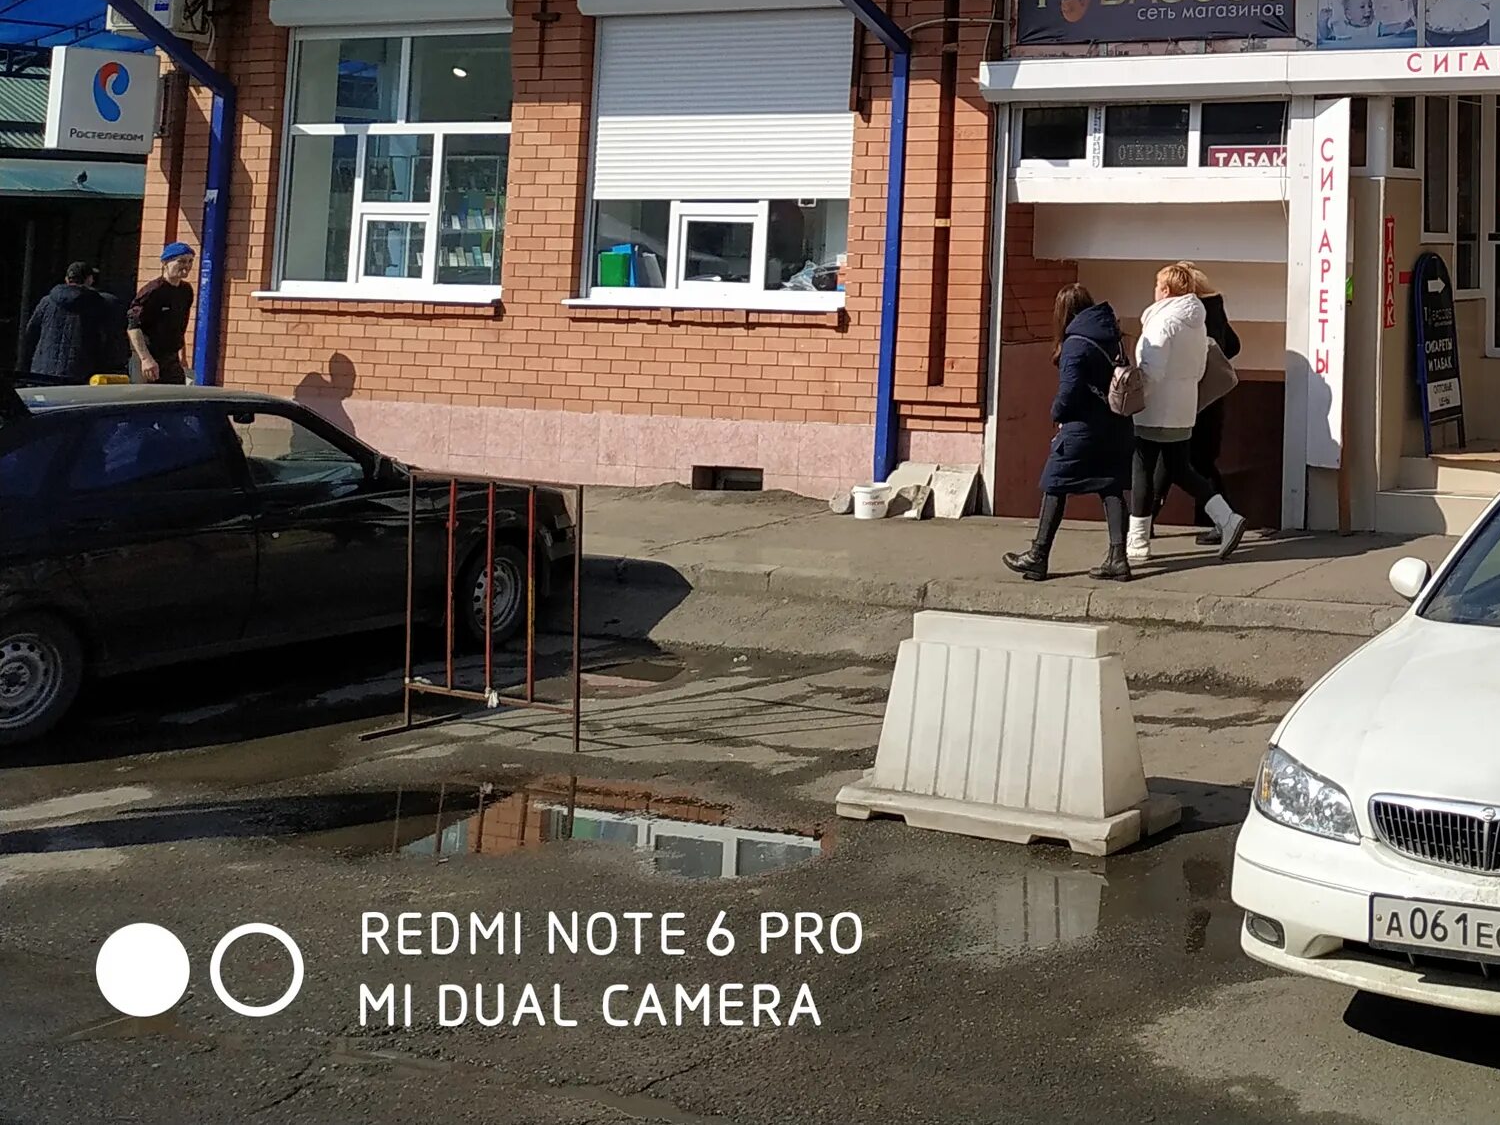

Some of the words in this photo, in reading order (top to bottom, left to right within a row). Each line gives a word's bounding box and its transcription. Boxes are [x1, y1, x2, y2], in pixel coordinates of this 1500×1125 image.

[1137, 5, 1176, 21] сеть
[1182, 3, 1285, 20] магазинов
[69, 128, 144, 142] Ростелеком
[1215, 152, 1287, 167] ТАБАК
[1315, 137, 1335, 374] СИГАРЕТЫ
[1385, 222, 1395, 326] ТАБАК
